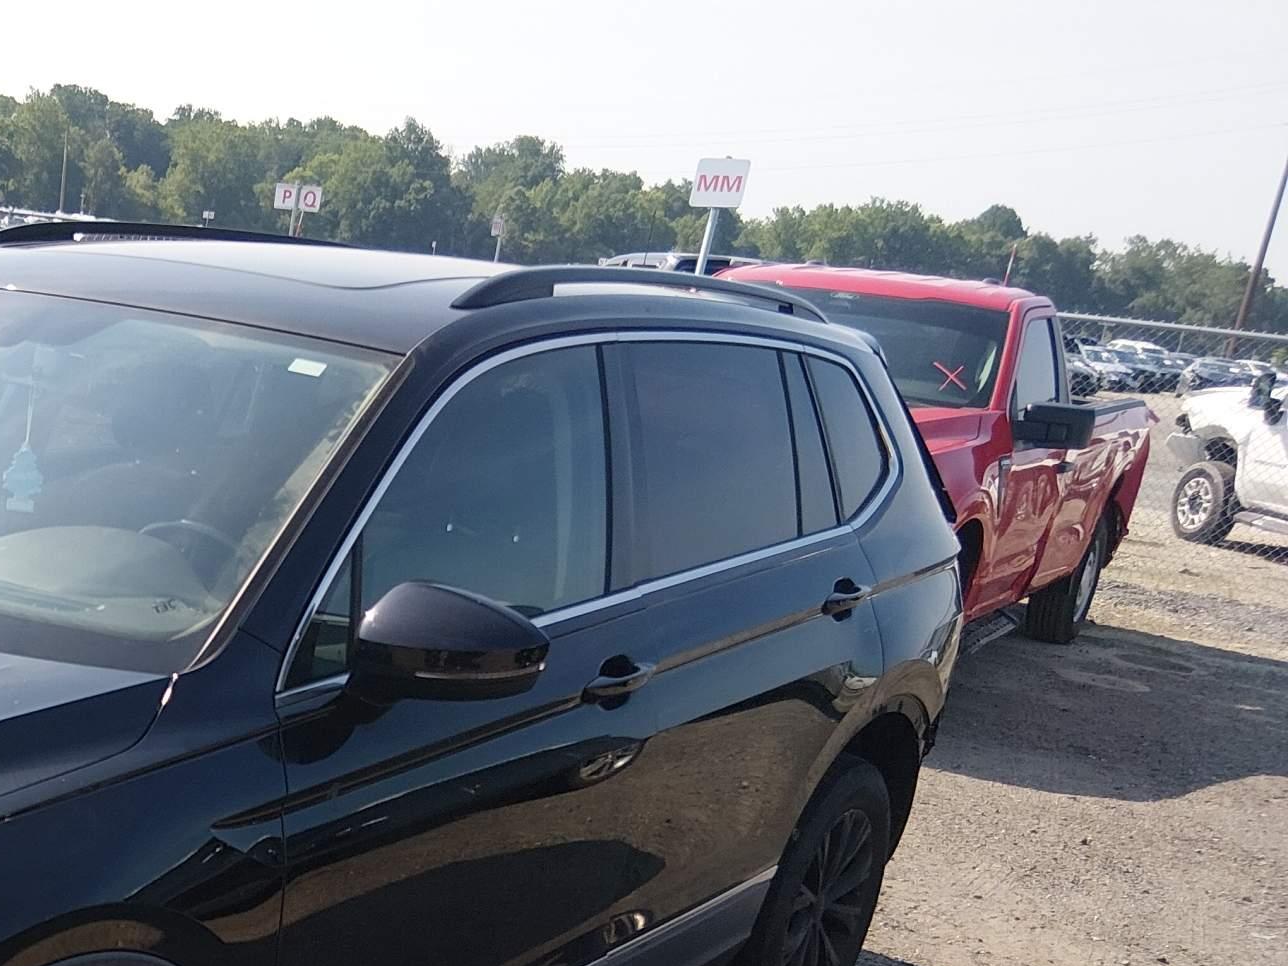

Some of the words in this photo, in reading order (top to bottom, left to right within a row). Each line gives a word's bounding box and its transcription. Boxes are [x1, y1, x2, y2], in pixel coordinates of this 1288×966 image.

[696, 174, 743, 193] MM
[282, 189, 292, 204] P
[303, 190, 317, 208] Q
